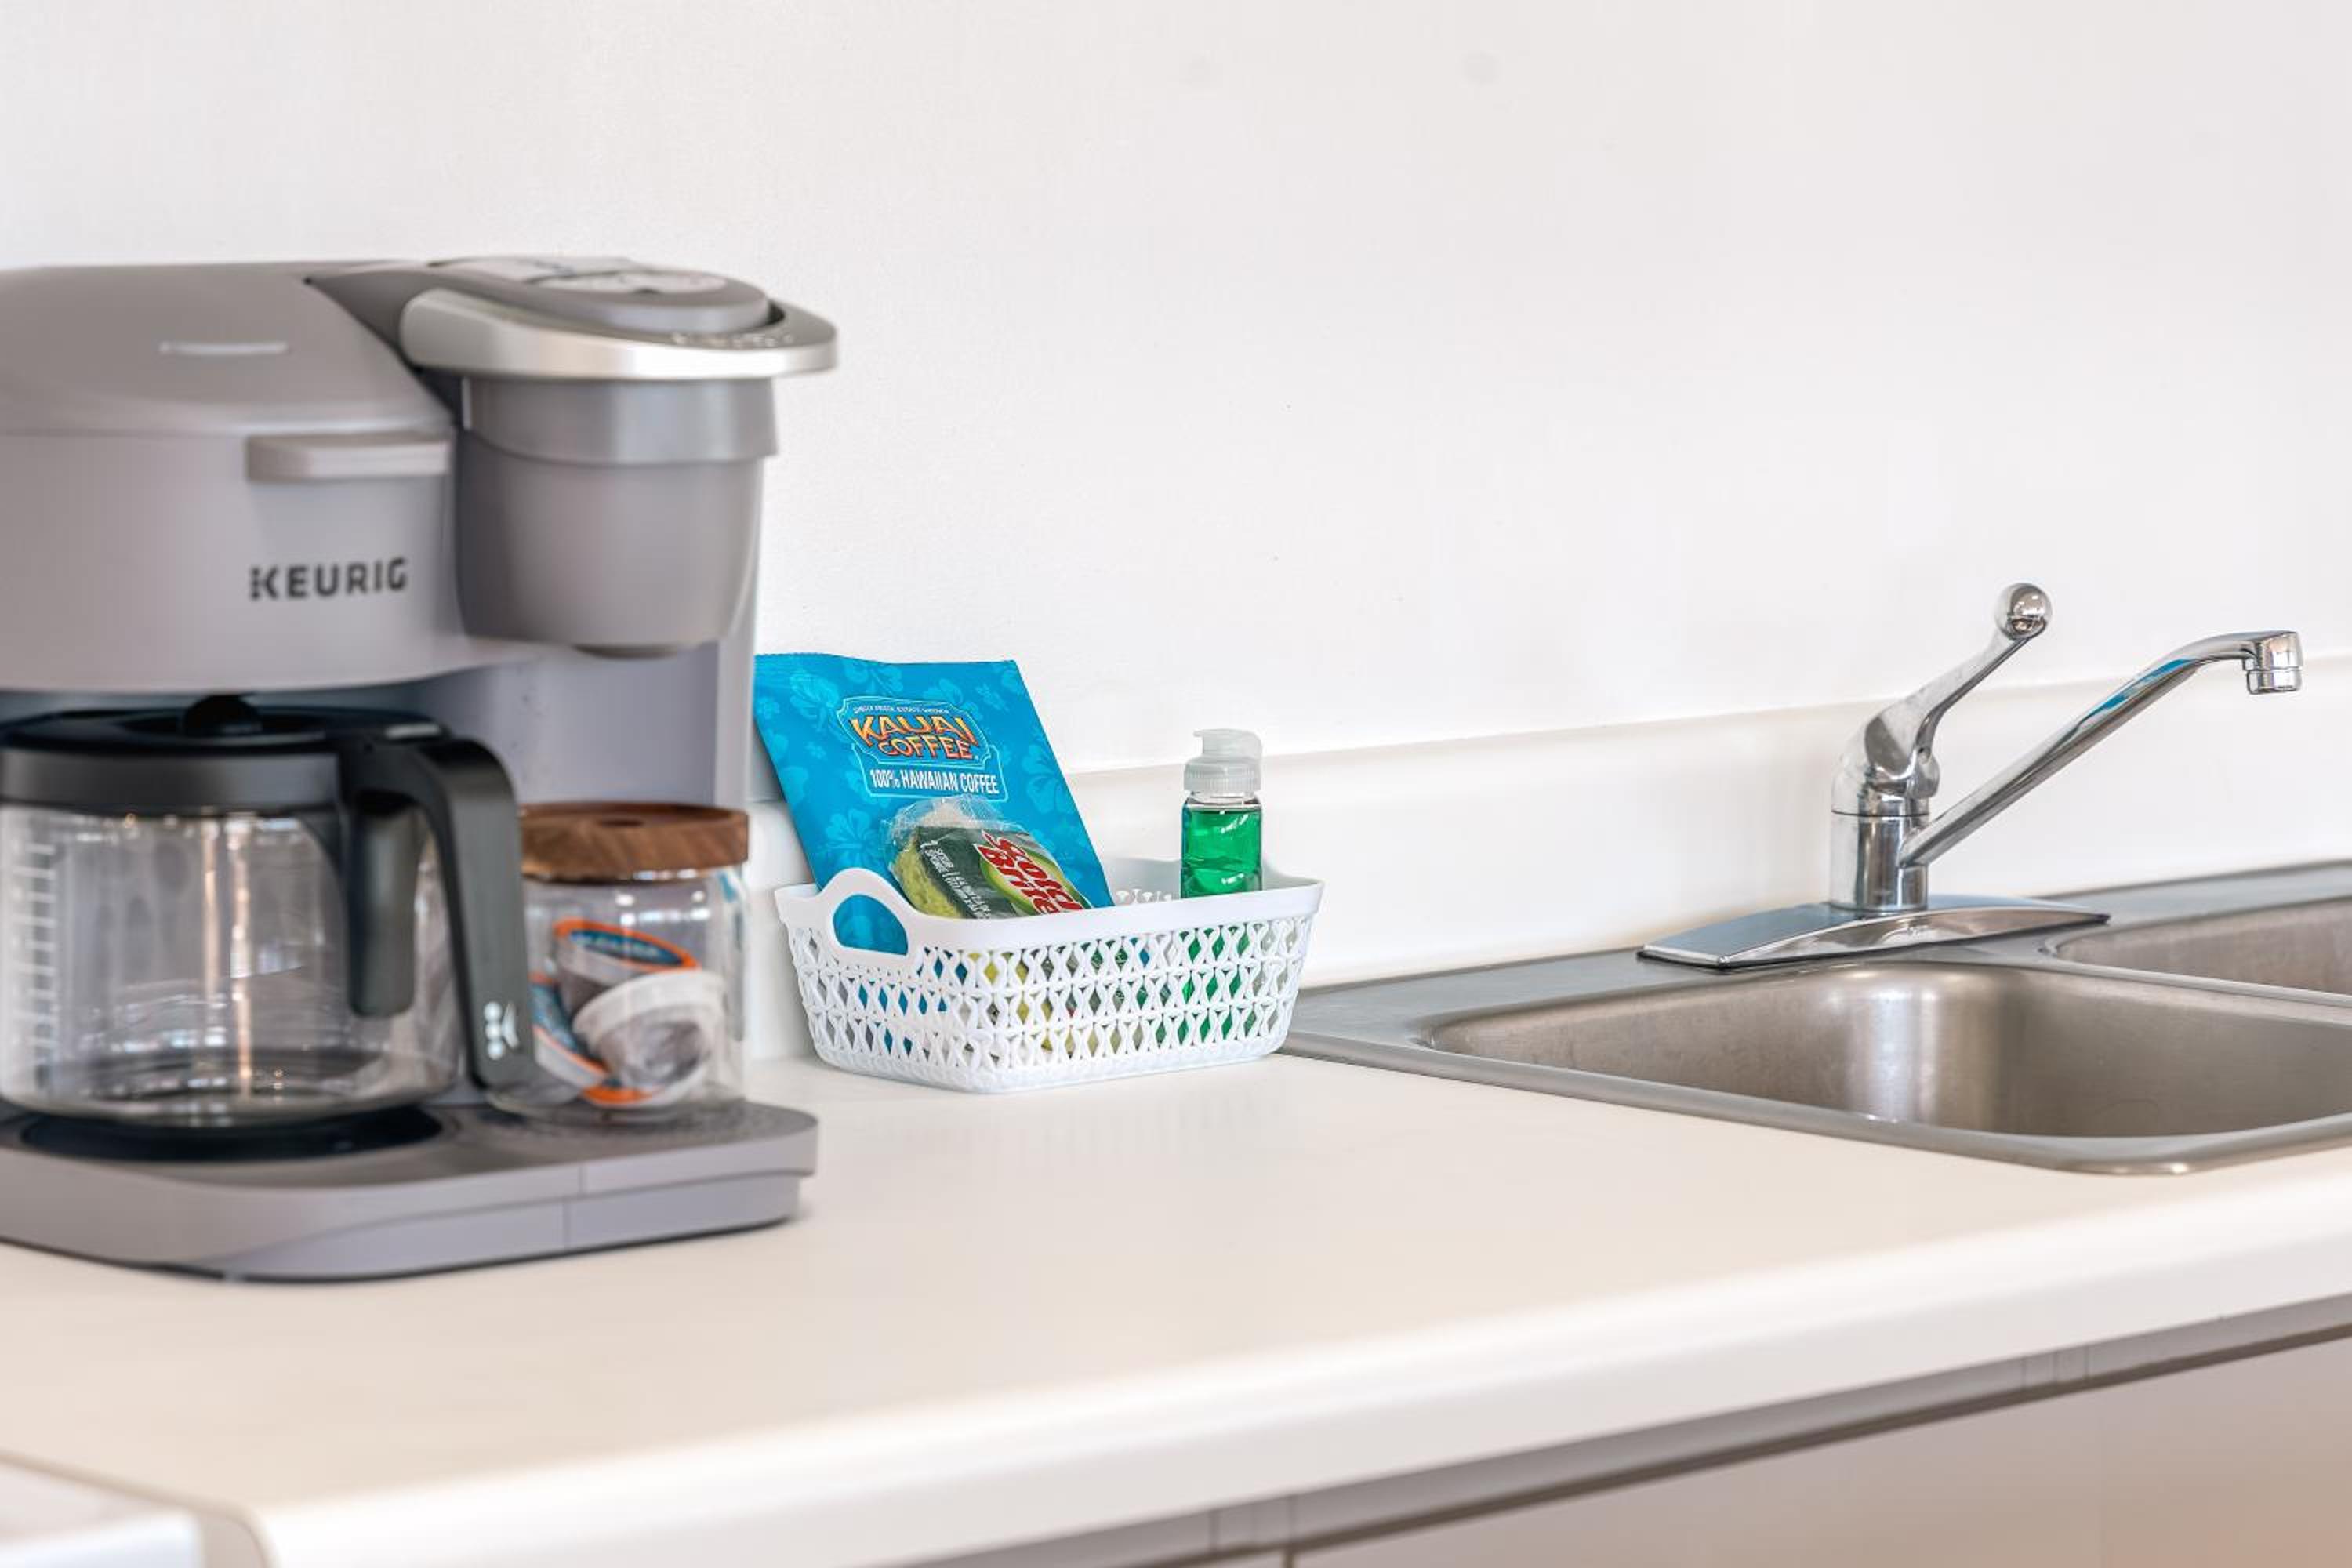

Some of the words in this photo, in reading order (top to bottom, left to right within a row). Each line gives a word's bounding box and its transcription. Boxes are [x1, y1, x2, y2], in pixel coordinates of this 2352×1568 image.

[250, 556, 407, 601] KEURIG
[849, 714, 978, 747] KAUAI
[877, 735, 974, 760] COFFEE
[869, 769, 901, 789] 100%
[900, 769, 955, 792] HAWAIIAN
[956, 772, 1000, 794] COFFEE
